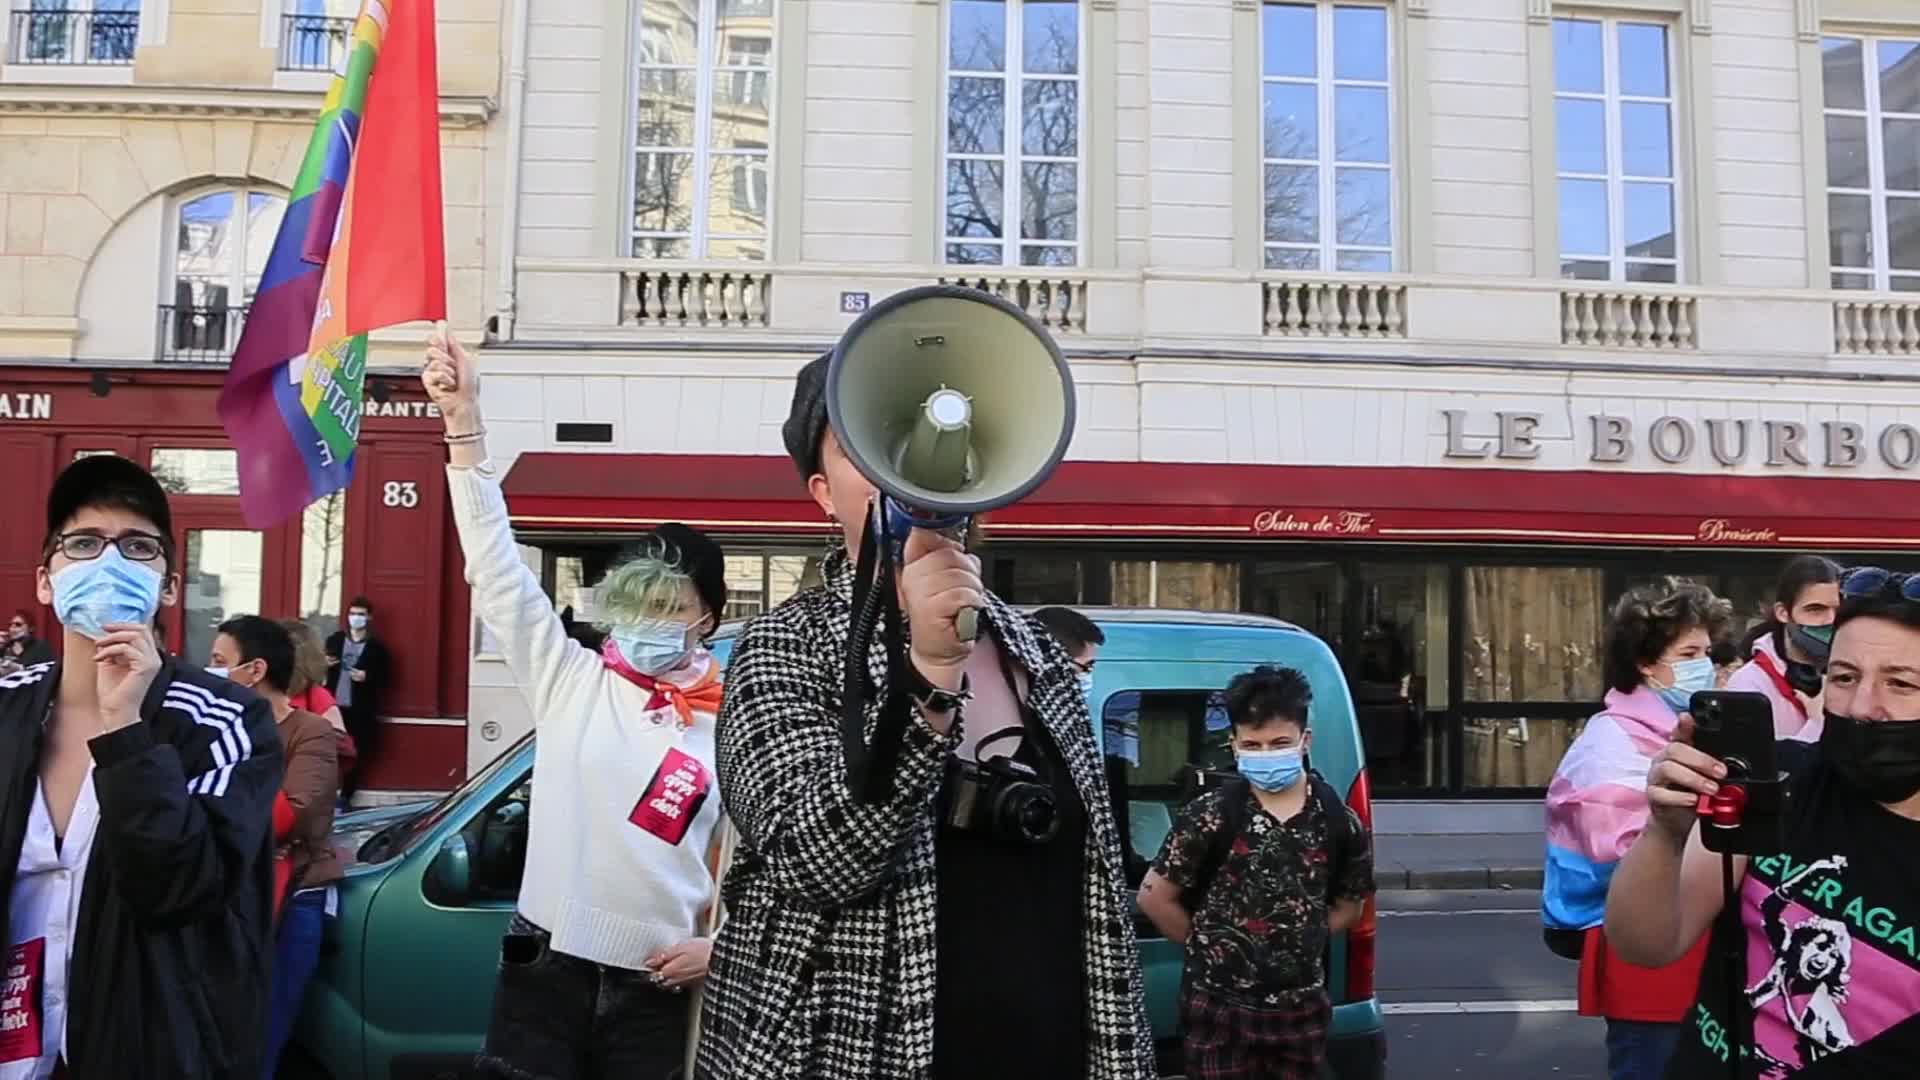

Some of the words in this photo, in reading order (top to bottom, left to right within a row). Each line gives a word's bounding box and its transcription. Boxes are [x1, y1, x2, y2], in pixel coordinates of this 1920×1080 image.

[844, 294, 866, 311] 85
[0, 393, 52, 419] AIN
[1442, 409, 1544, 461] LE
[1589, 413, 1920, 470] BOURBO
[382, 481, 418, 508] 83
[1253, 510, 1309, 534] Salon
[1311, 514, 1334, 532] de
[1335, 510, 1376, 534] Thé
[1698, 518, 1776, 542] Brasserie
[1754, 853, 1843, 910] EVR
[1841, 895, 1920, 961] AGA
